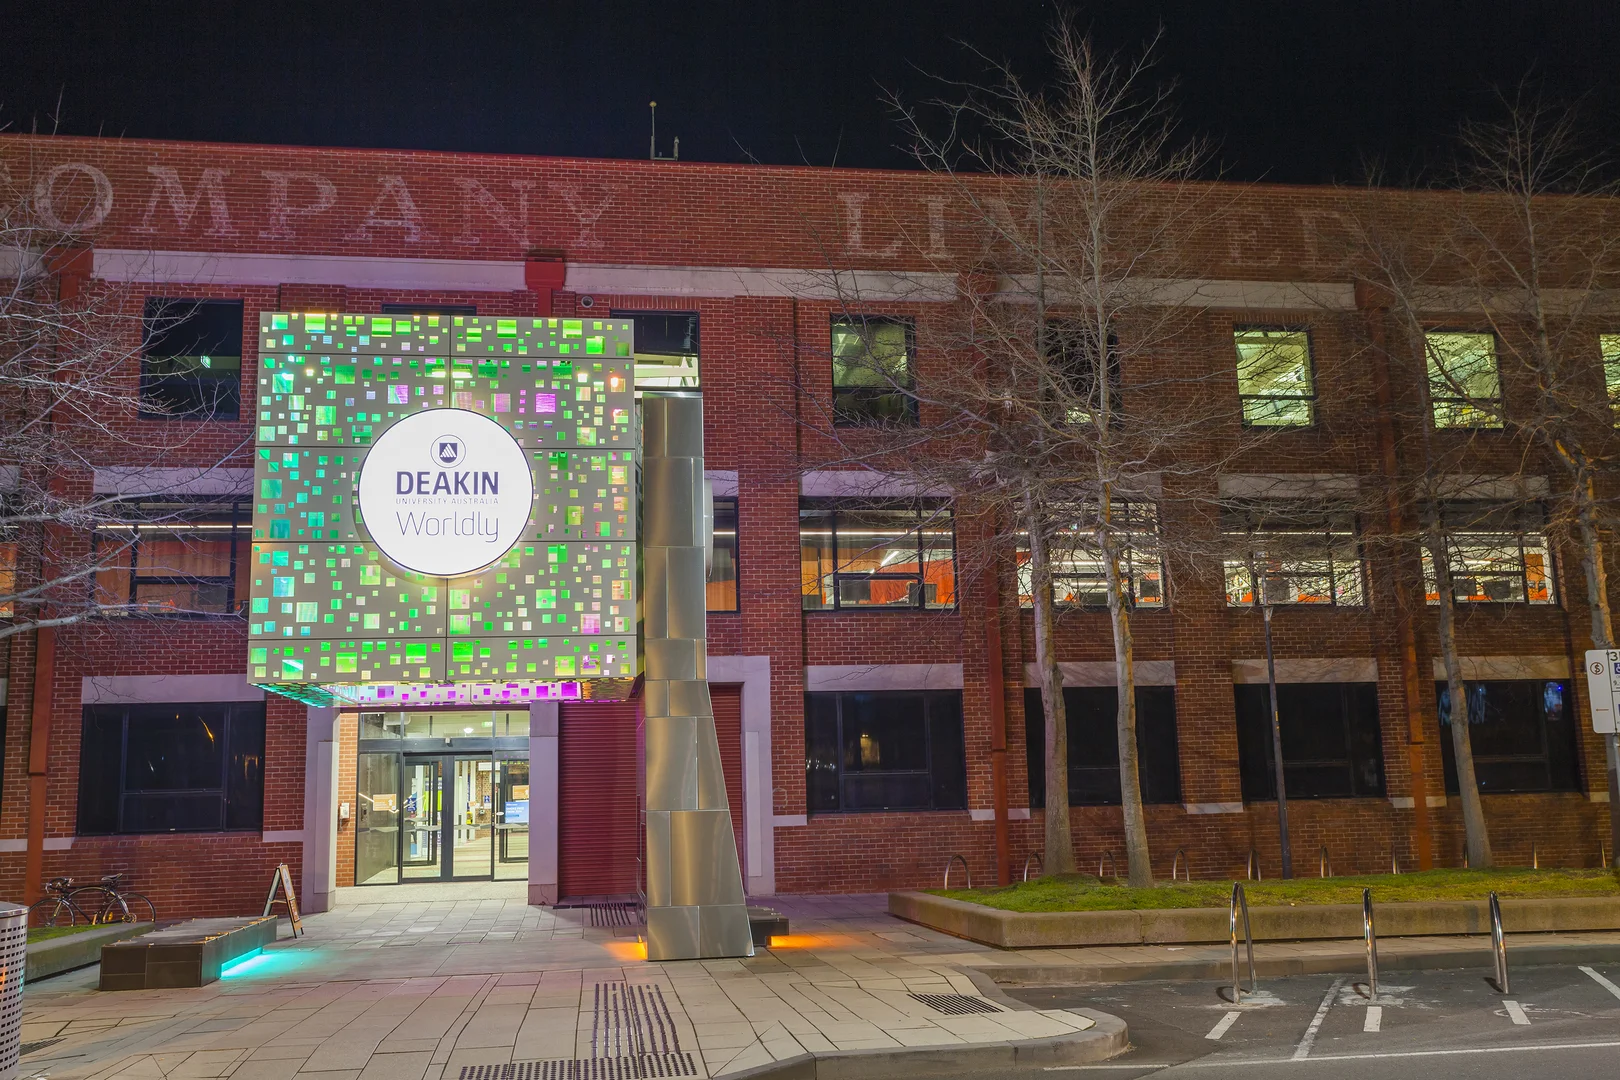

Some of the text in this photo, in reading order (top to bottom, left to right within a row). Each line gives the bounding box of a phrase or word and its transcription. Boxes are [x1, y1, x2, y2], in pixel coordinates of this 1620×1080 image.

[0, 161, 1366, 270] OMPANY LIMTED
[396, 471, 499, 495] DEAKIN
[395, 497, 499, 505] UNIVERSITY AUSTRALIA
[396, 511, 499, 543] Worldly
[1610, 651, 1620, 661] 3
